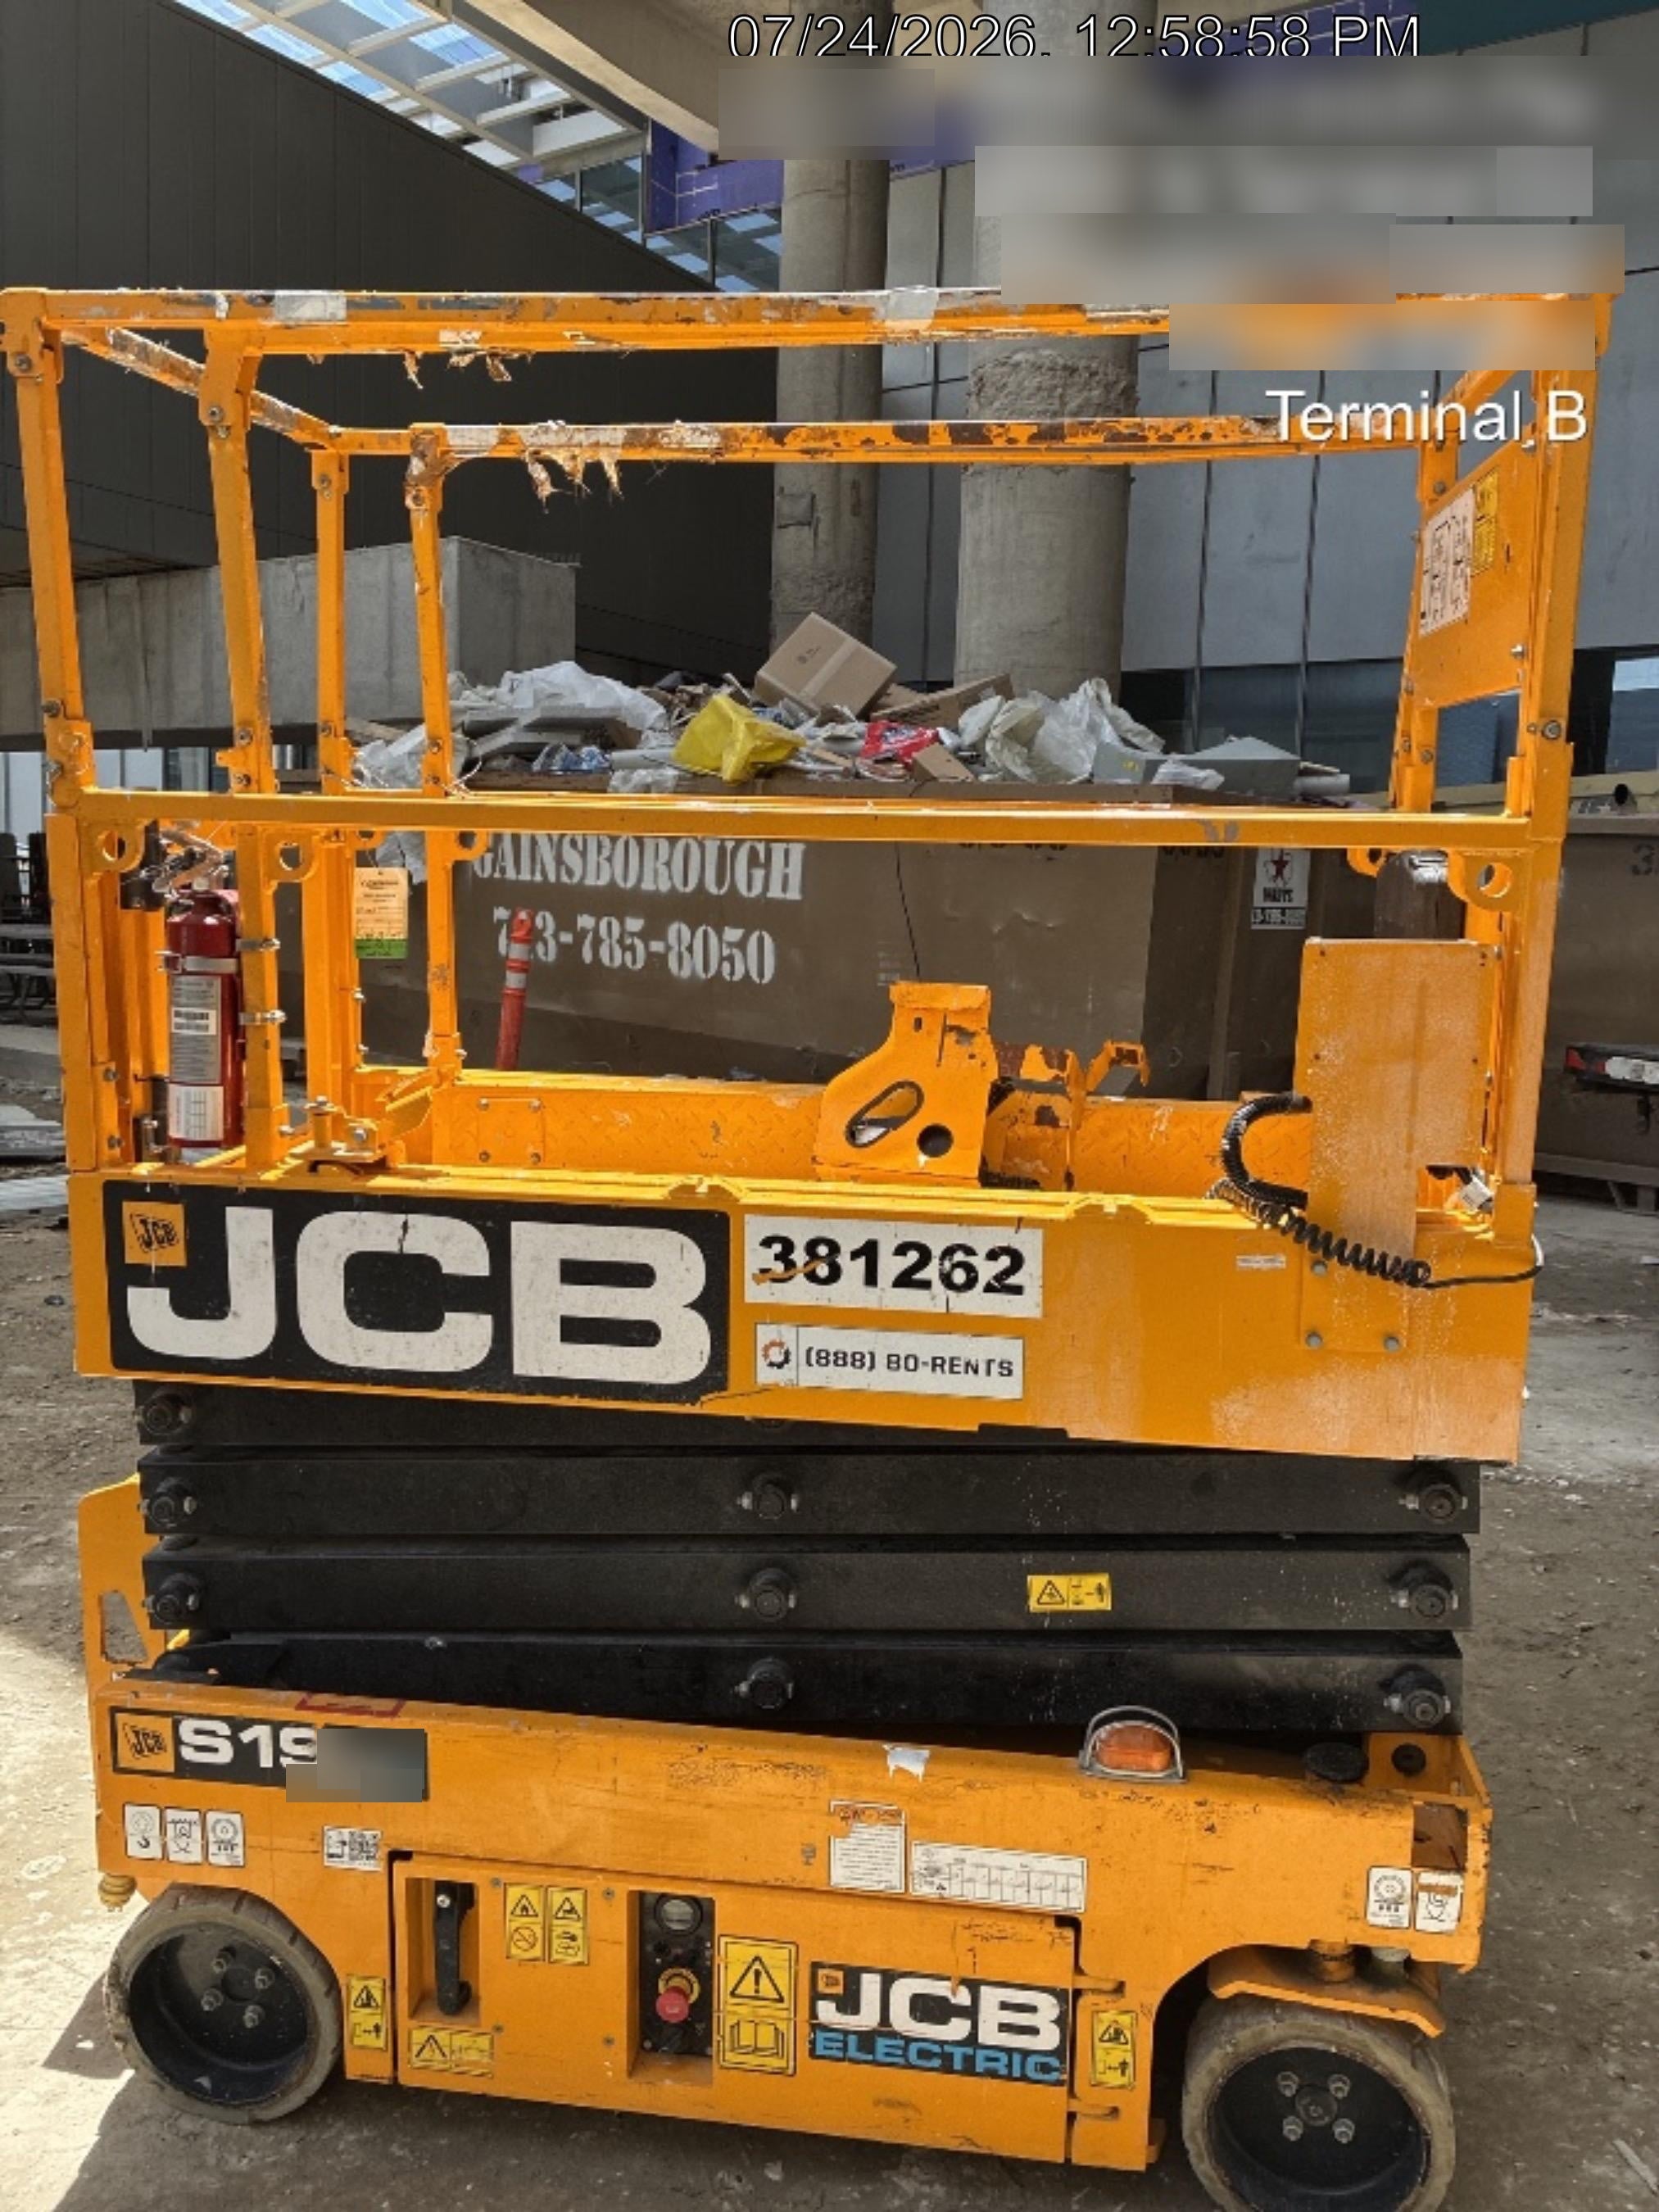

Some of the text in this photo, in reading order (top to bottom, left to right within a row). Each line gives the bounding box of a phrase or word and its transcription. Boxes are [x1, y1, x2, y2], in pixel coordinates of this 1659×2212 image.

[493, 906, 776, 985] 73-785-8050
[138, 1217, 177, 1249] JCB
[126, 1205, 711, 1385] JCB
[758, 1234, 1026, 1296] 381262
[805, 1346, 876, 1372] (888)
[815, 1973, 1061, 2051] JCB
[814, 2028, 1061, 2083] ELECTRIC
